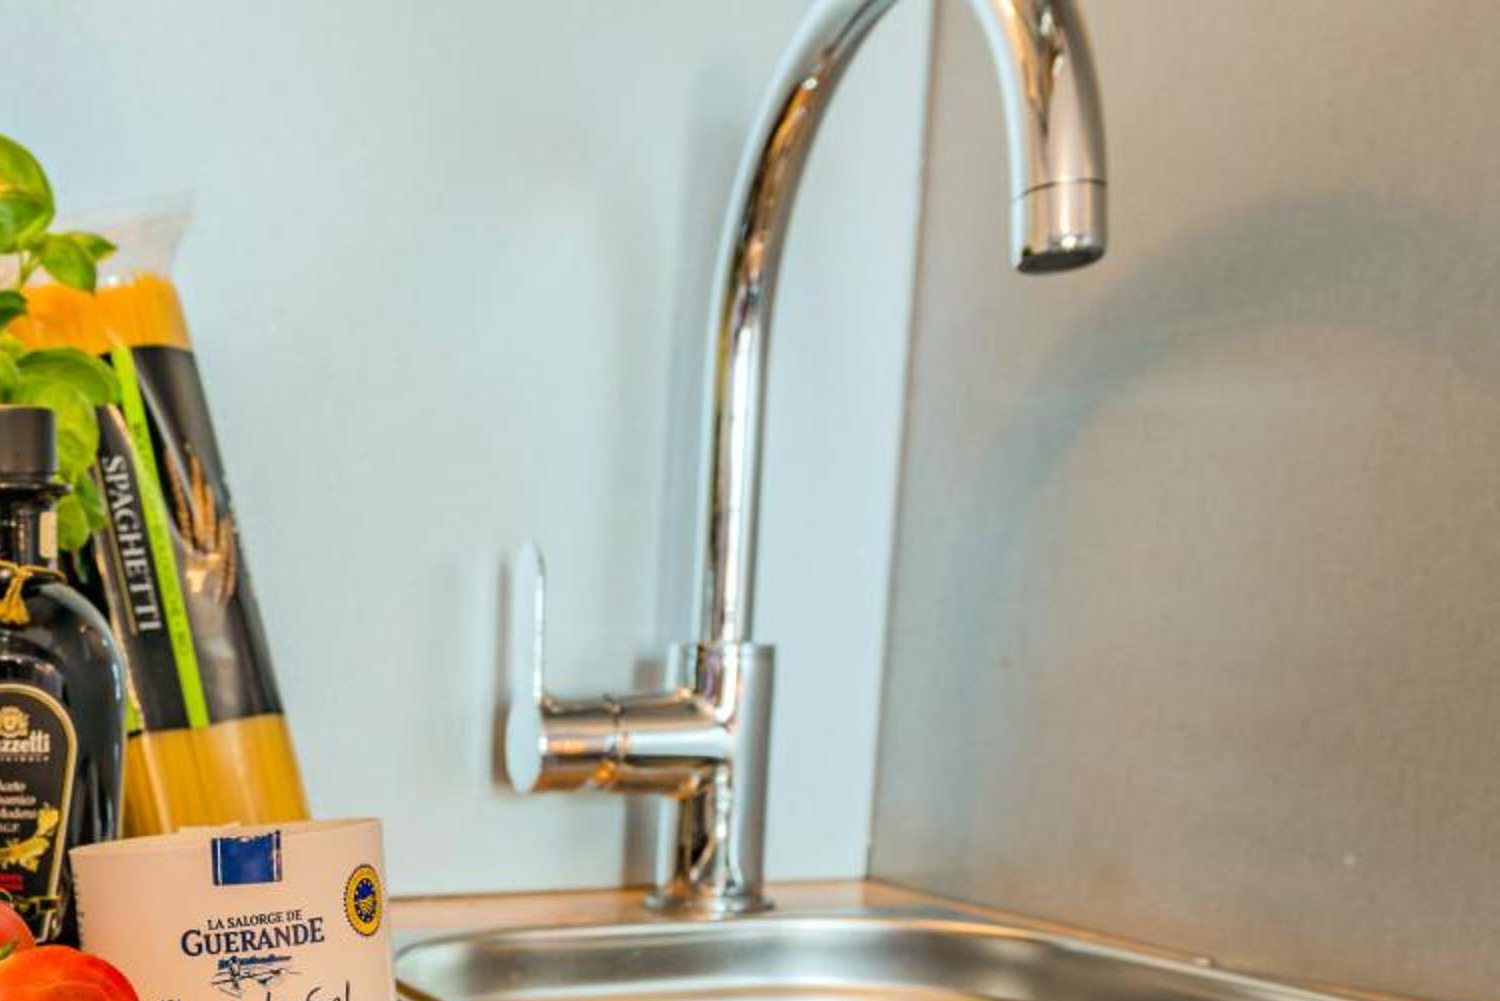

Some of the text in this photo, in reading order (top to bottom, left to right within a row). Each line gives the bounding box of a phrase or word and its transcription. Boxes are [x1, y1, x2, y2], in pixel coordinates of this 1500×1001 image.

[103, 455, 162, 630] SPAGHETTI
[180, 917, 325, 957] GUERANDE
[207, 909, 303, 931] LA SALORGE DE
